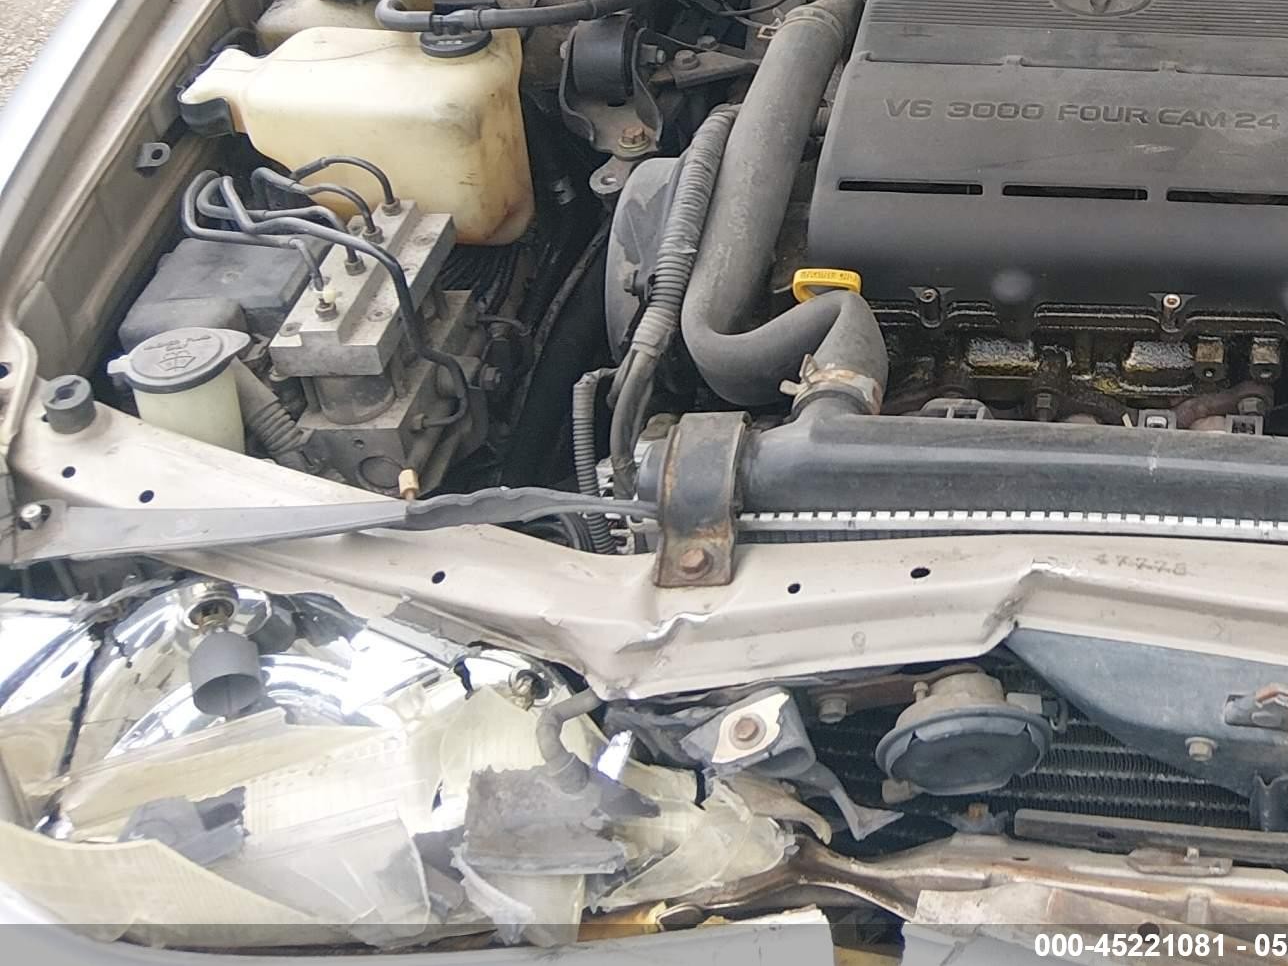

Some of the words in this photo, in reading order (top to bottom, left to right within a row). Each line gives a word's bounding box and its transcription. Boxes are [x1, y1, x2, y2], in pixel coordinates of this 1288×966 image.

[885, 98, 933, 119] V6
[947, 100, 1045, 121] 3000
[1057, 103, 1150, 125] FOUR
[1158, 107, 1227, 129] CAM
[1234, 111, 1281, 131] 24
